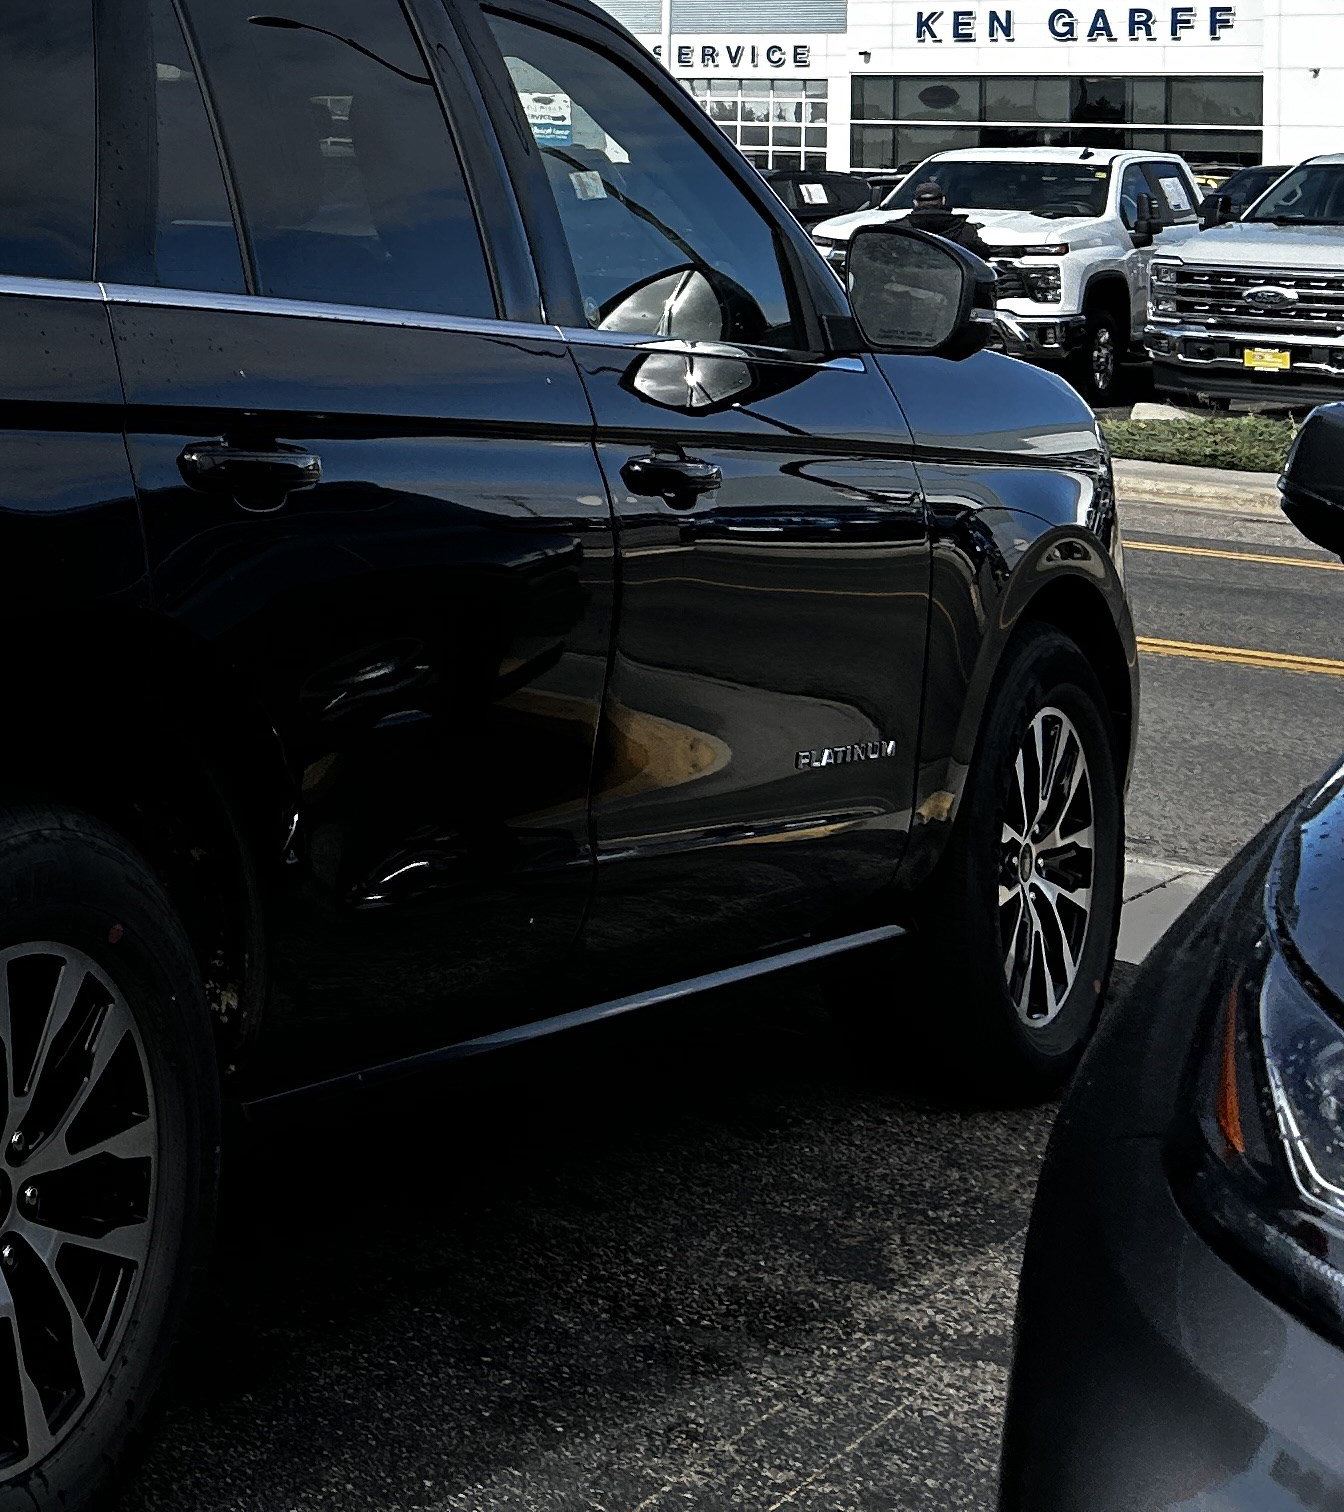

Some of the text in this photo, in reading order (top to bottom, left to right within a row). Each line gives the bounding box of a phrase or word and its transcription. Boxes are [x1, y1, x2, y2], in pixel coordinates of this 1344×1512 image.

[916, 6, 1236, 42] KEN GARFF
[796, 739, 897, 769] PLATINUM
